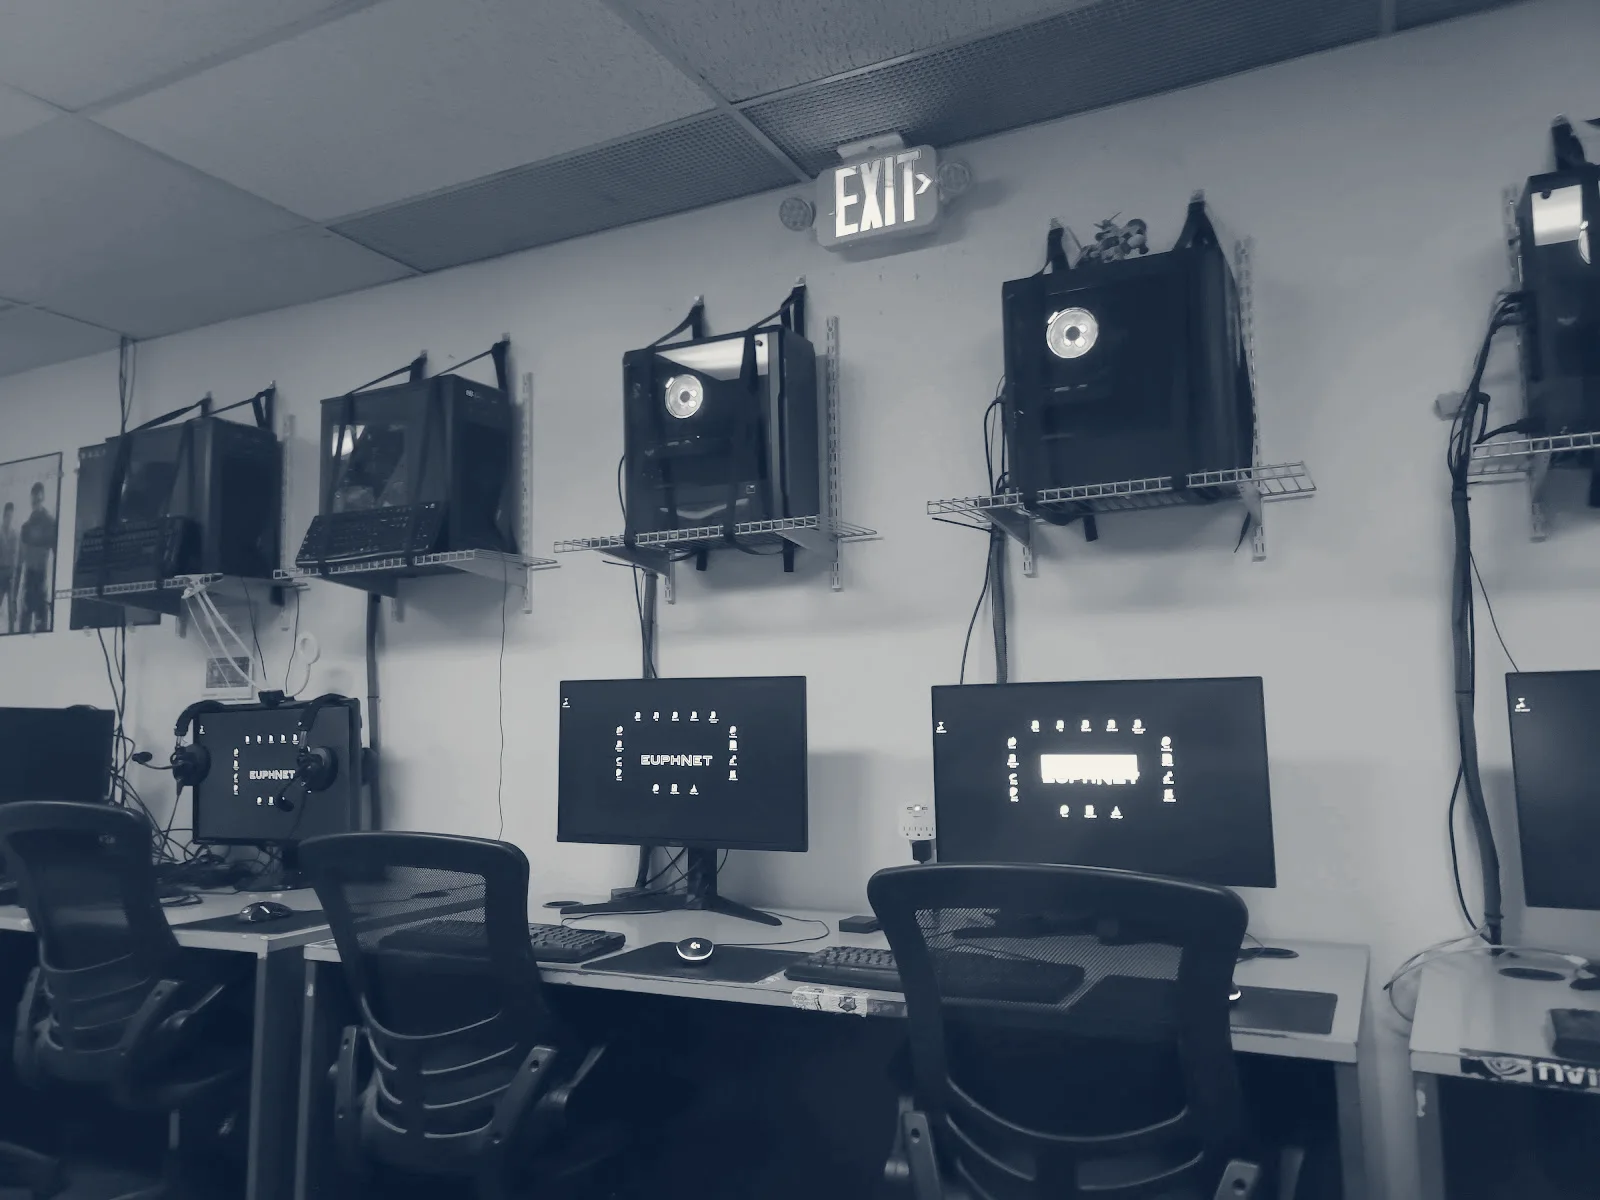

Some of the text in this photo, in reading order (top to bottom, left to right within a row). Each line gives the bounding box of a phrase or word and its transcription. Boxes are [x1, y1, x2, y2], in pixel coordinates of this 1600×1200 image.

[835, 150, 921, 238] EXIT
[640, 754, 713, 767] EUPHNET
[249, 769, 296, 780] EUPHNET
